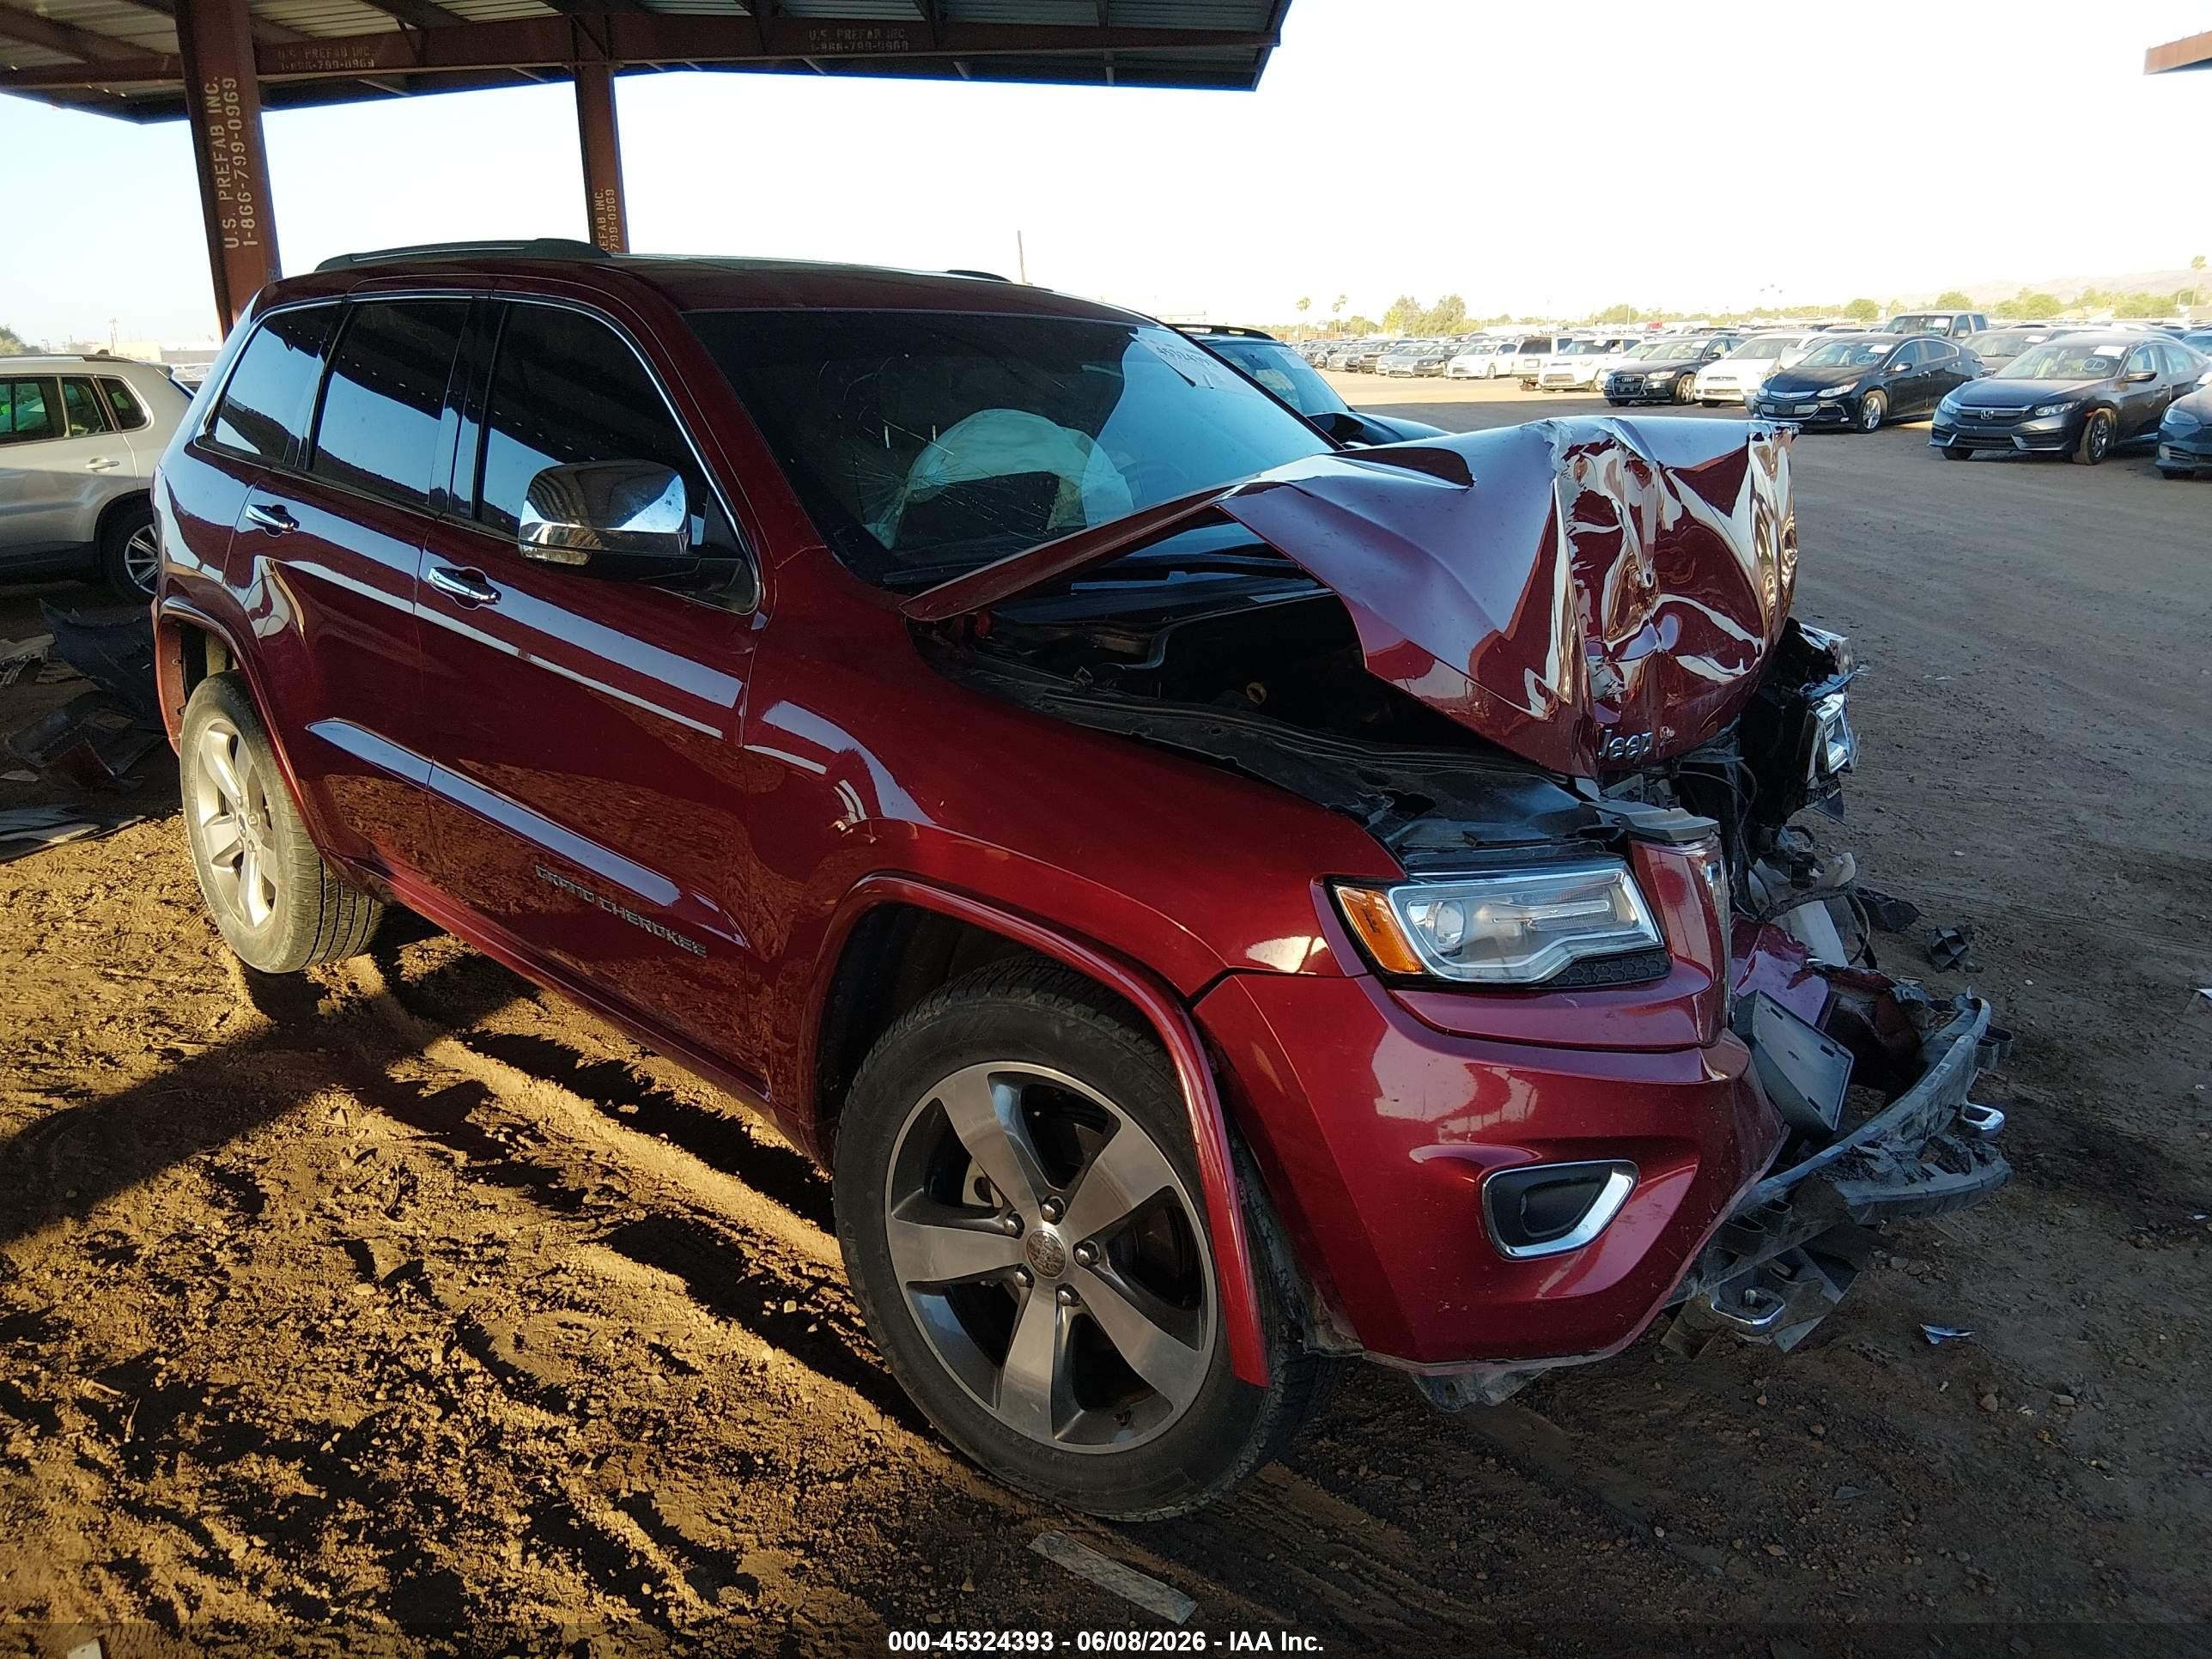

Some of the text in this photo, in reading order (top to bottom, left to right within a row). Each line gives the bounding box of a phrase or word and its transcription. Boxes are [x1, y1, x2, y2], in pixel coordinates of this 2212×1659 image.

[205, 76, 223, 114] INC.
[210, 125, 234, 201] PREFAB
[222, 77, 258, 246] 1-866-799-0969
[594, 188, 605, 210] INC.
[1597, 728, 1654, 764] Jeep
[599, 896, 708, 959] CHEROKEE
